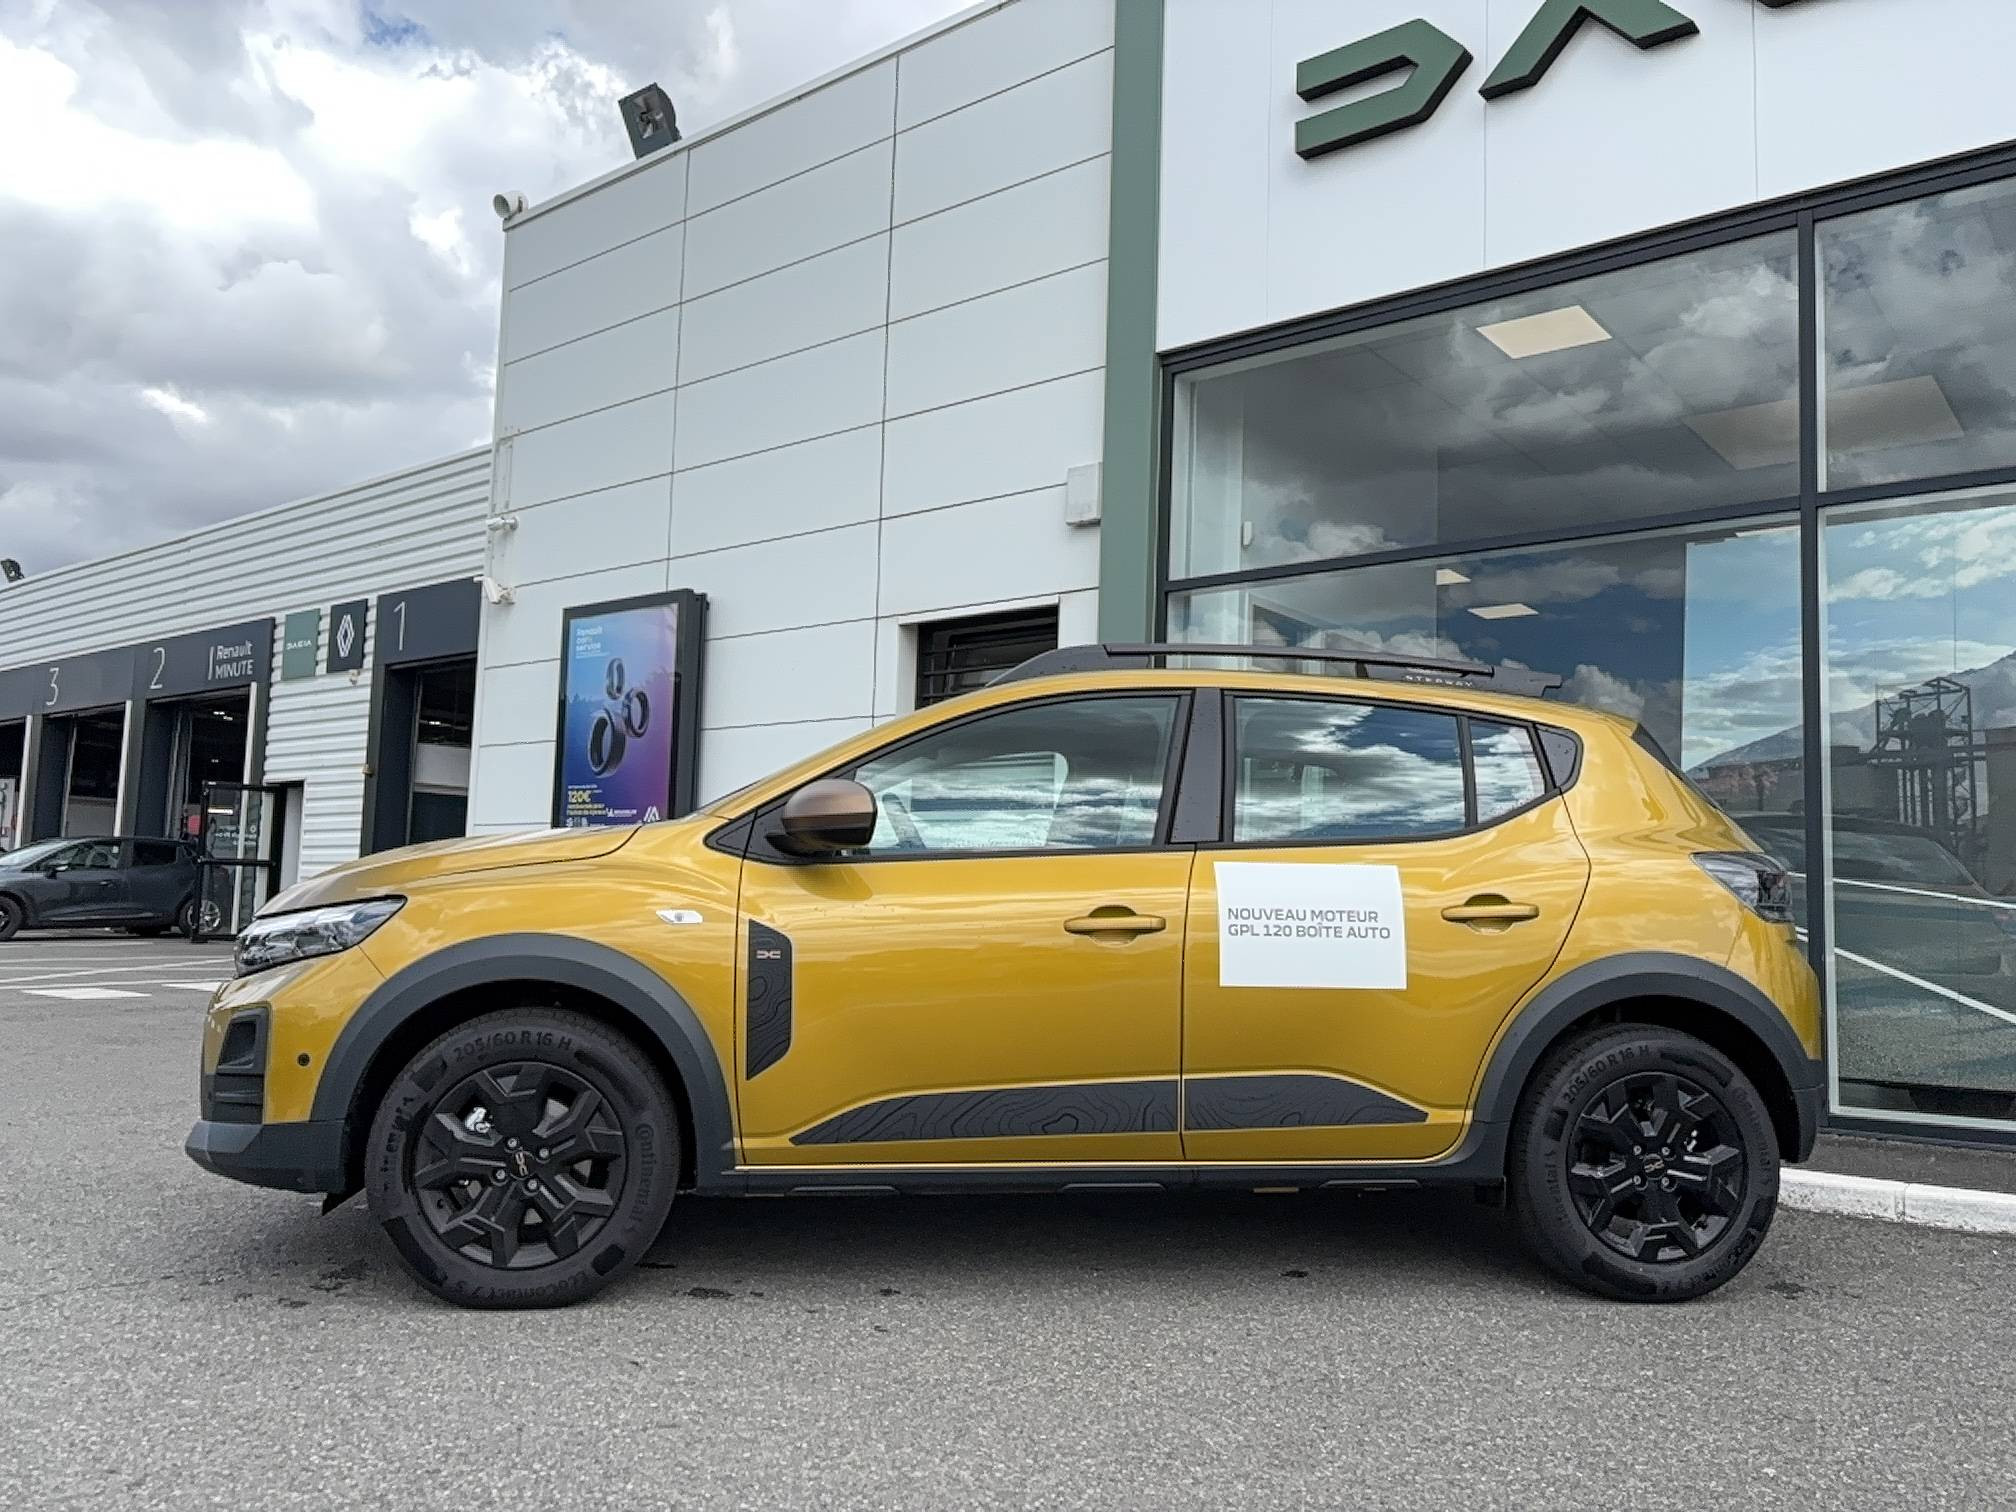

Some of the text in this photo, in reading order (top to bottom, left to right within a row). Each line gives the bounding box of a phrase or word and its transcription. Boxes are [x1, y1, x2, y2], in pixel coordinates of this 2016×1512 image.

[393, 601, 408, 651] 1
[216, 640, 253, 660] Renault
[286, 640, 312, 650] DACIA
[150, 648, 166, 690] 2
[215, 659, 254, 680] MINUTE
[45, 667, 59, 705] 3
[1405, 675, 1473, 687] STEPWAY
[1227, 908, 1379, 923] NOUVEAU MOTEUR
[1228, 922, 1391, 940] GPL 120 BOÎTE AUTO
[453, 1030, 573, 1060] 205/60 R 16 H
[1562, 1060, 1607, 1104] 205/60
[1606, 1053, 1619, 1066] R
[1619, 1047, 1634, 1060] 16
